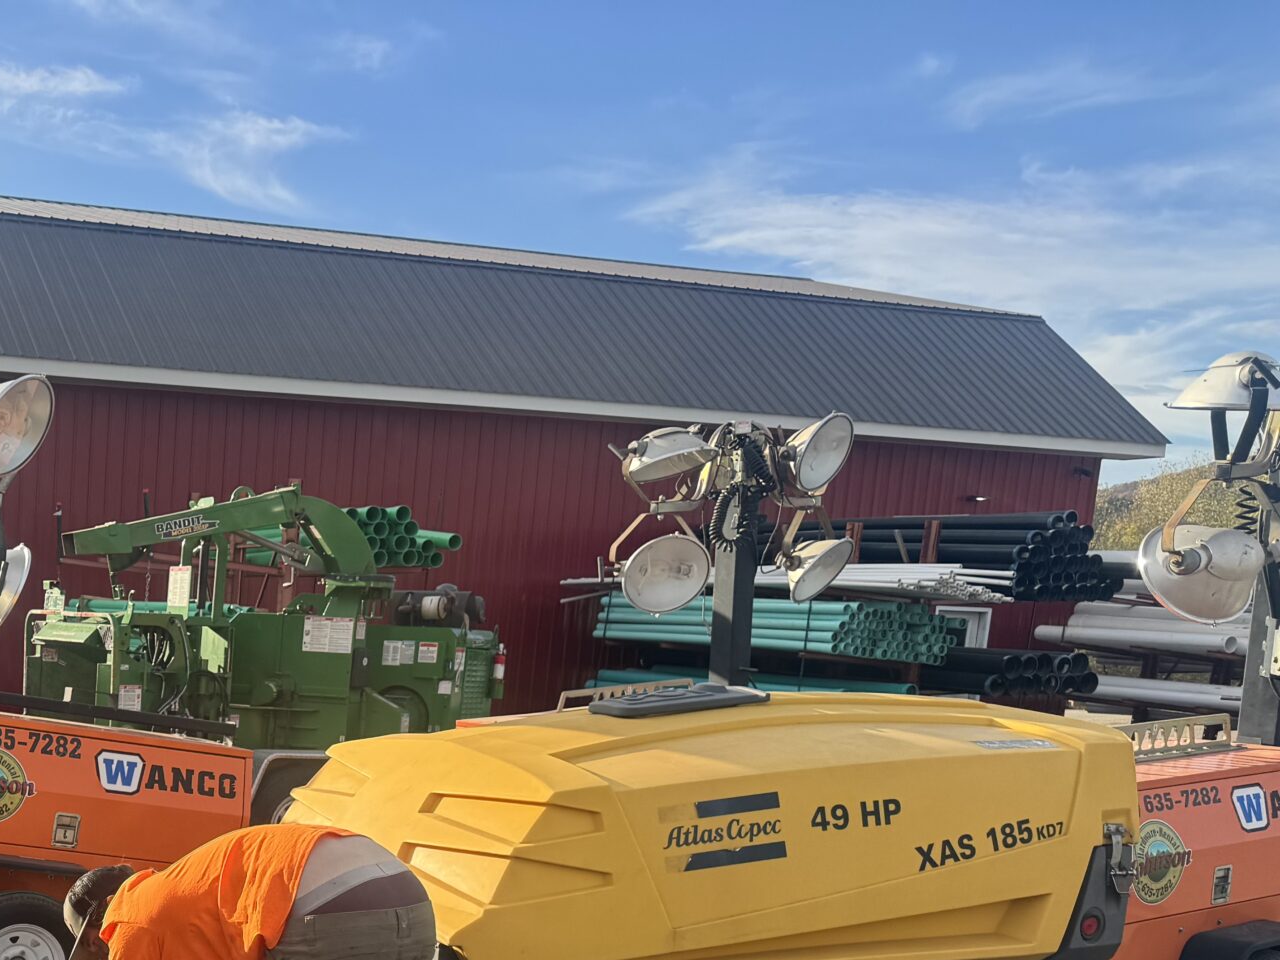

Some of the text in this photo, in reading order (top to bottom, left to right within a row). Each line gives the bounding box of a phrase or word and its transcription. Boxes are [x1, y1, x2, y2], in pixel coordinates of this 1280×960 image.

[155, 515, 203, 533] BANDIT
[102, 757, 238, 800] WANCO
[810, 798, 902, 832] 49 HP
[1142, 785, 1222, 814] 635-7282
[663, 824, 724, 850] Atlas
[914, 817, 1065, 872] XAS 185 KD7
[1132, 848, 1192, 881] ohnson
